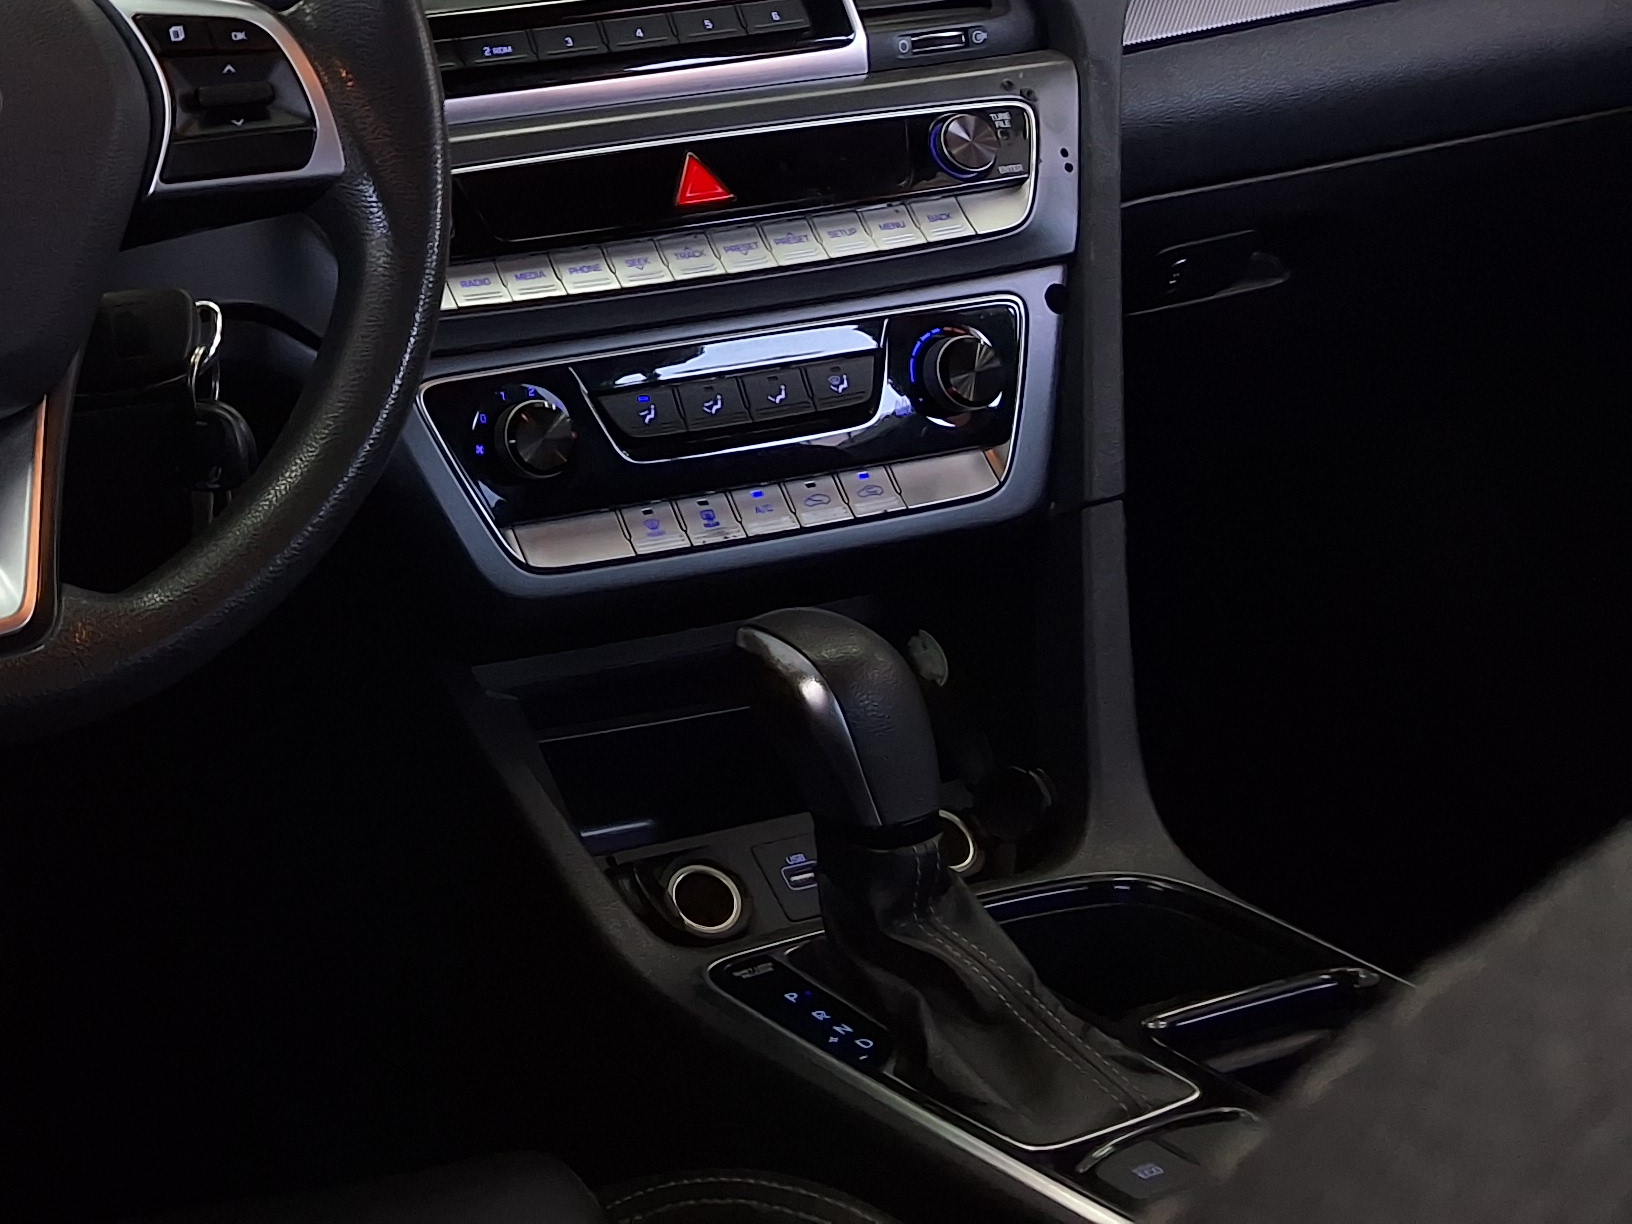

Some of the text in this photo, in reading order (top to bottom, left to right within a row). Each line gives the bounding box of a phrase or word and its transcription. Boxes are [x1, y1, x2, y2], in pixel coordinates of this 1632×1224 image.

[704, 19, 713, 29] 5
[635, 28, 644, 38] 4
[566, 36, 574, 47] 3
[926, 212, 953, 223] BACK
[879, 221, 907, 231] MENU
[826, 228, 858, 239] SETUP
[773, 234, 809, 246] PRESET
[624, 257, 651, 268] SEEK
[569, 263, 603, 275] PHONE
[514, 270, 547, 282] MEDIA
[459, 277, 492, 289] RADIO
[784, 992, 799, 1003] P
[832, 1023, 854, 1035] N
[854, 1038, 874, 1049] D
